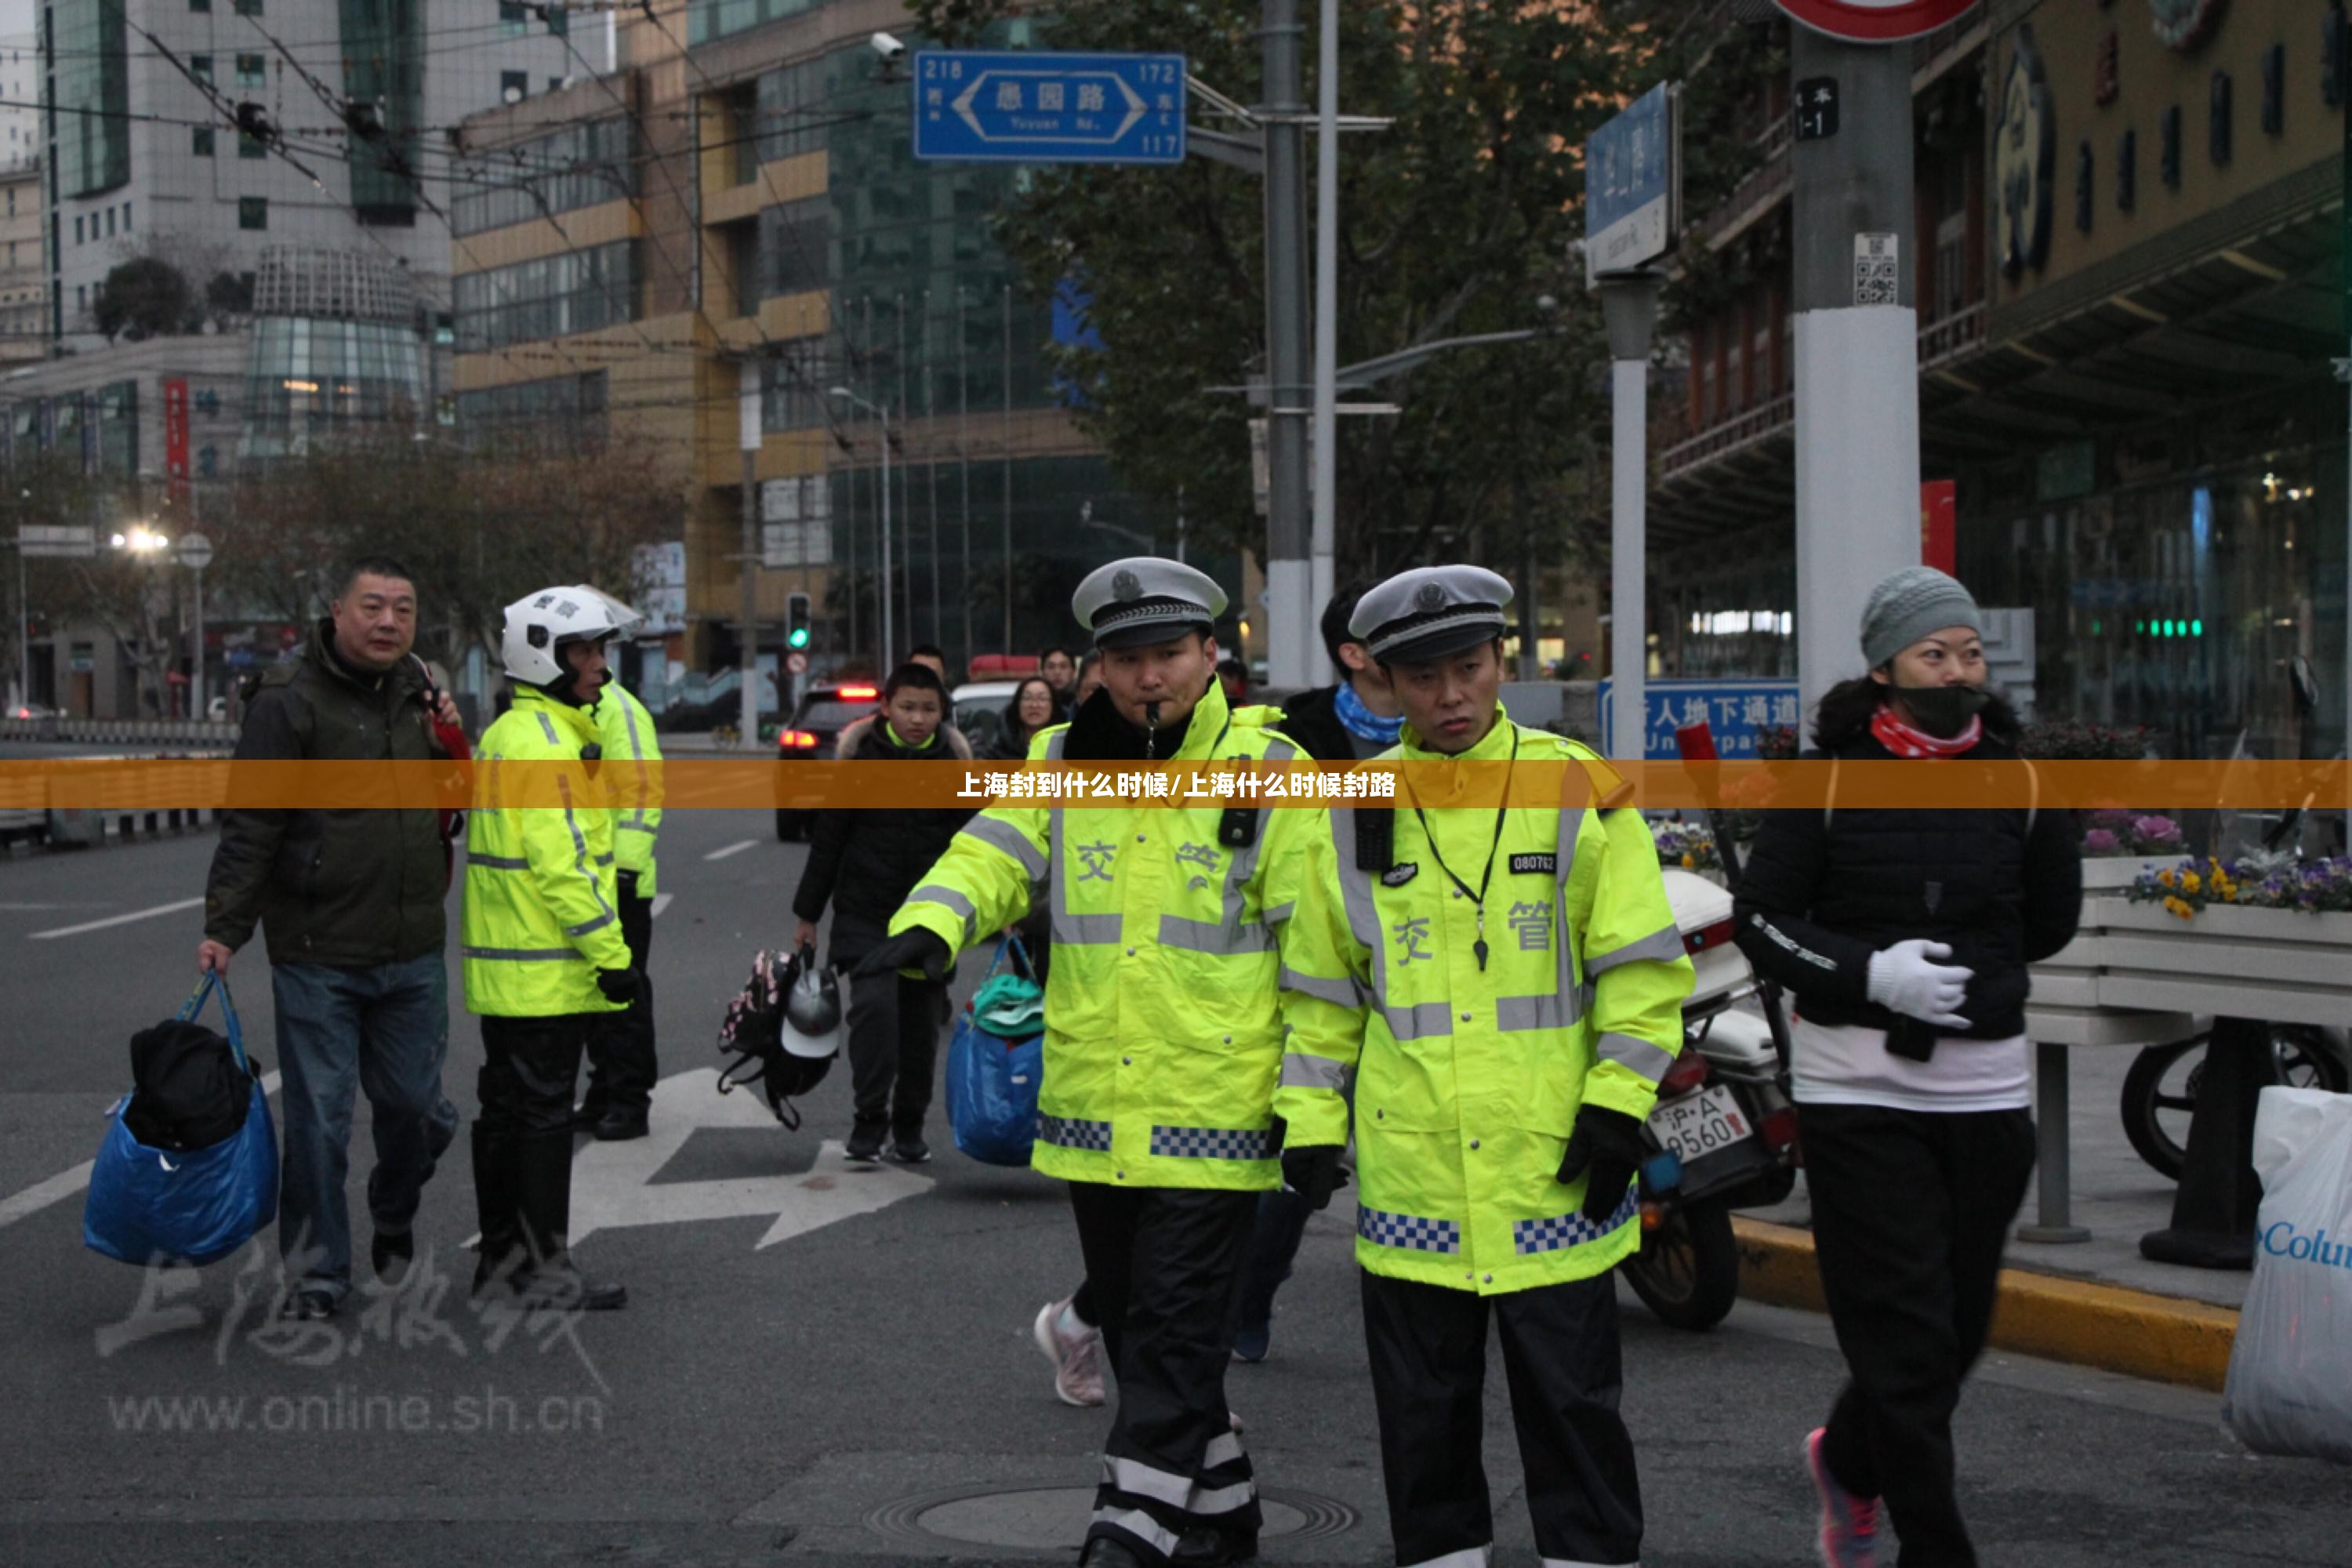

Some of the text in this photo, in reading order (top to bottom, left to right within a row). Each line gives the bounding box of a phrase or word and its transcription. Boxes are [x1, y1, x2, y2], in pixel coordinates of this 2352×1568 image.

[925, 60, 962, 79] 218
[1139, 64, 1174, 83] 172
[1142, 135, 1177, 154] 117
[1667, 1118, 1731, 1159] 9560
